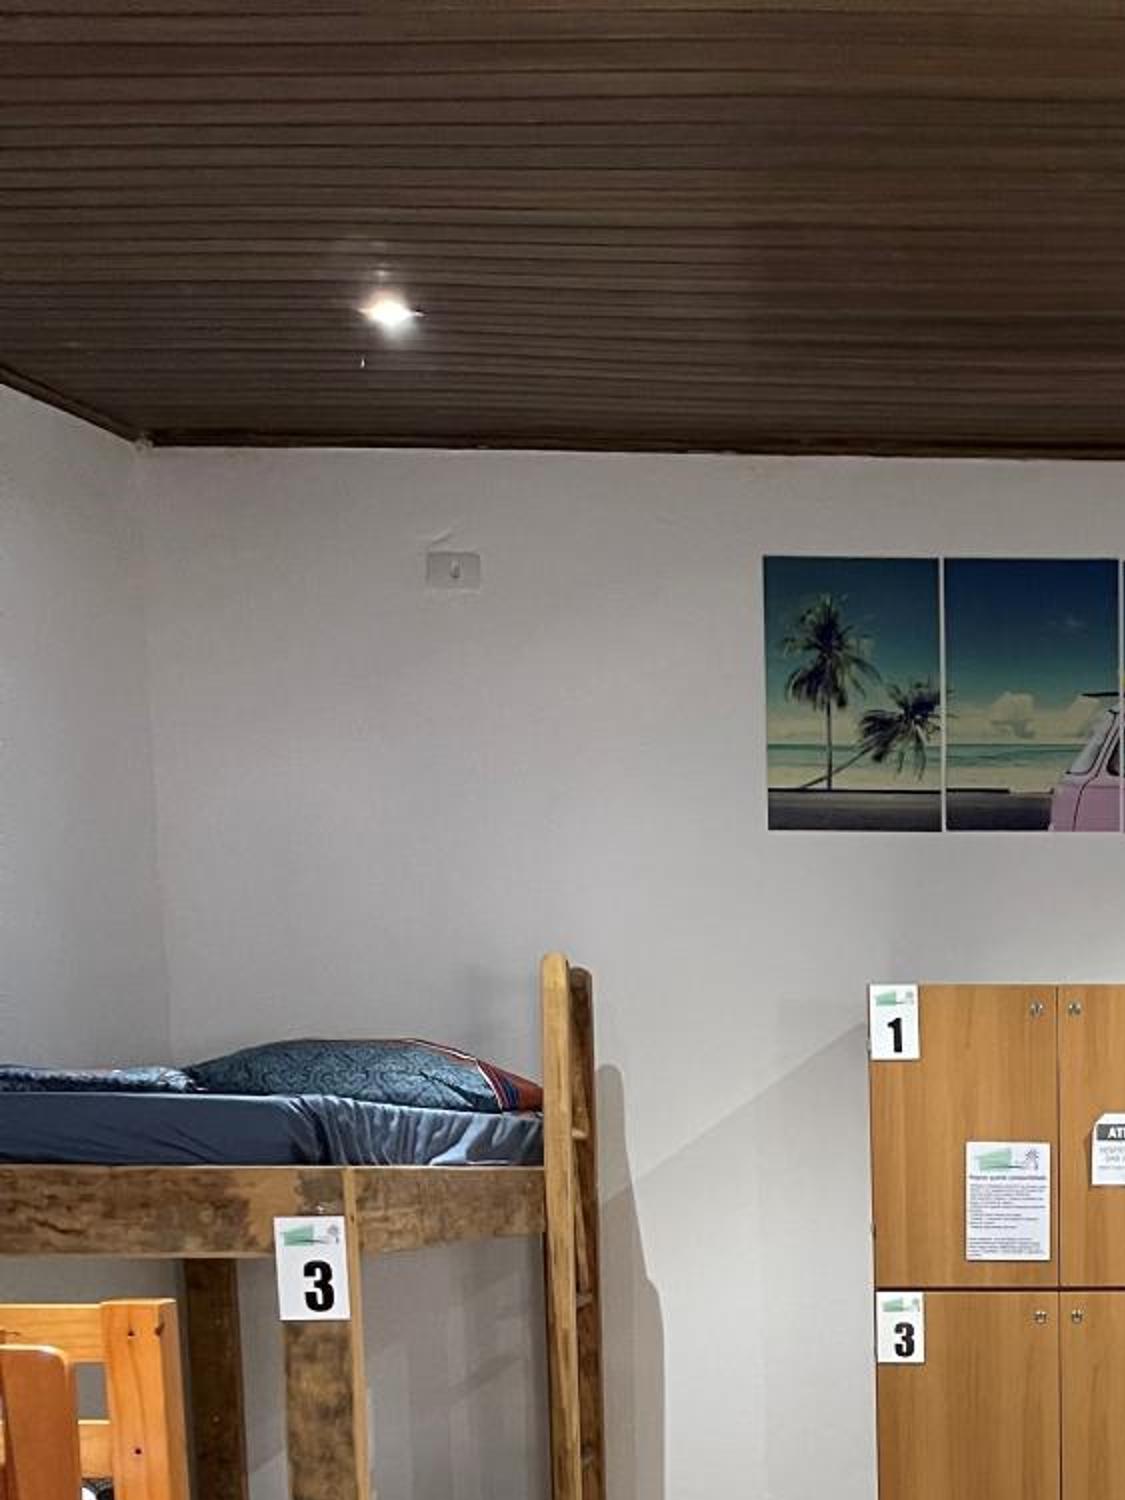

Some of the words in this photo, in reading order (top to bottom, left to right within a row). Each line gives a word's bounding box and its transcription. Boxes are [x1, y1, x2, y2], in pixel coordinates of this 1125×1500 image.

[887, 1017, 903, 1053] 1
[303, 1260, 335, 1312] 3
[894, 1322, 915, 1358] 3
